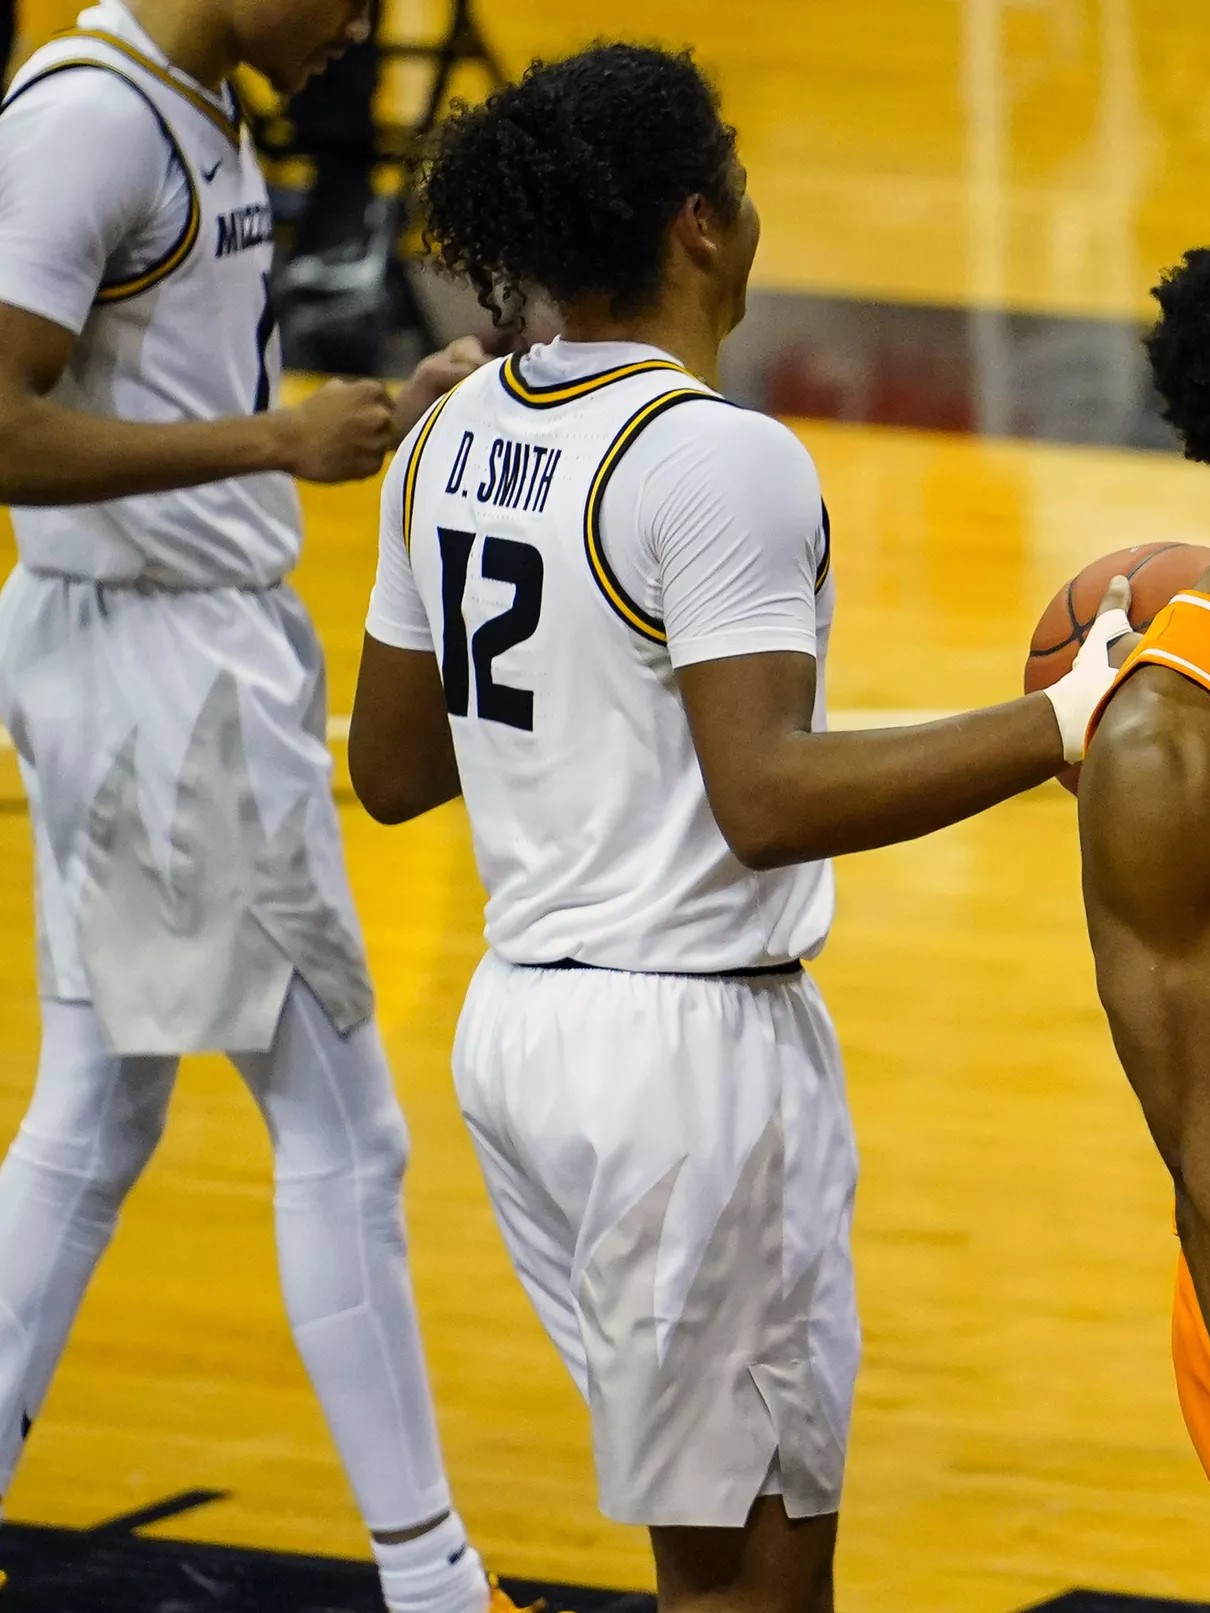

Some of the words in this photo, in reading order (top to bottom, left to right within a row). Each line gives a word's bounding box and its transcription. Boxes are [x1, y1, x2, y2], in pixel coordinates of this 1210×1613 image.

[445, 430, 473, 498] D.
[477, 438, 562, 513] SMITH
[437, 526, 544, 733] 12
